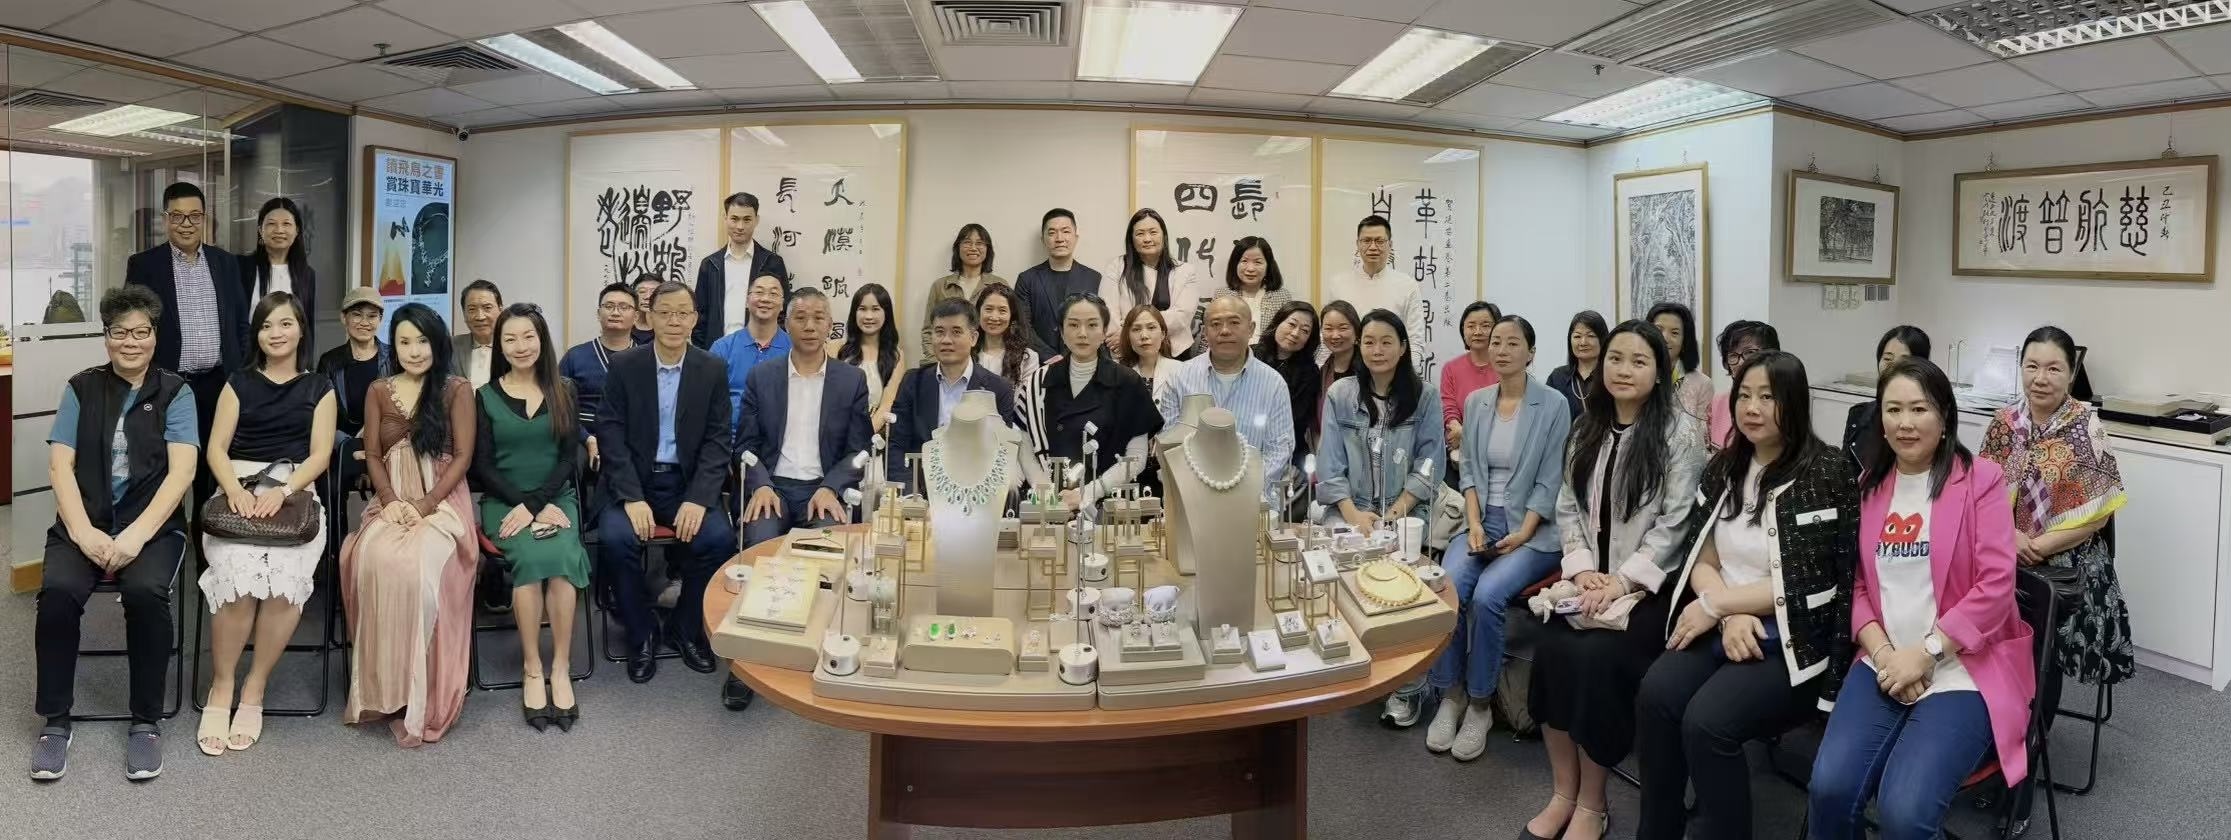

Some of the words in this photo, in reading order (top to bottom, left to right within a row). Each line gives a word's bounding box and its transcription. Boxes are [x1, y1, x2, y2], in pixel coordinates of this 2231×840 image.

[385, 176, 444, 197] 賞珠寶華光
